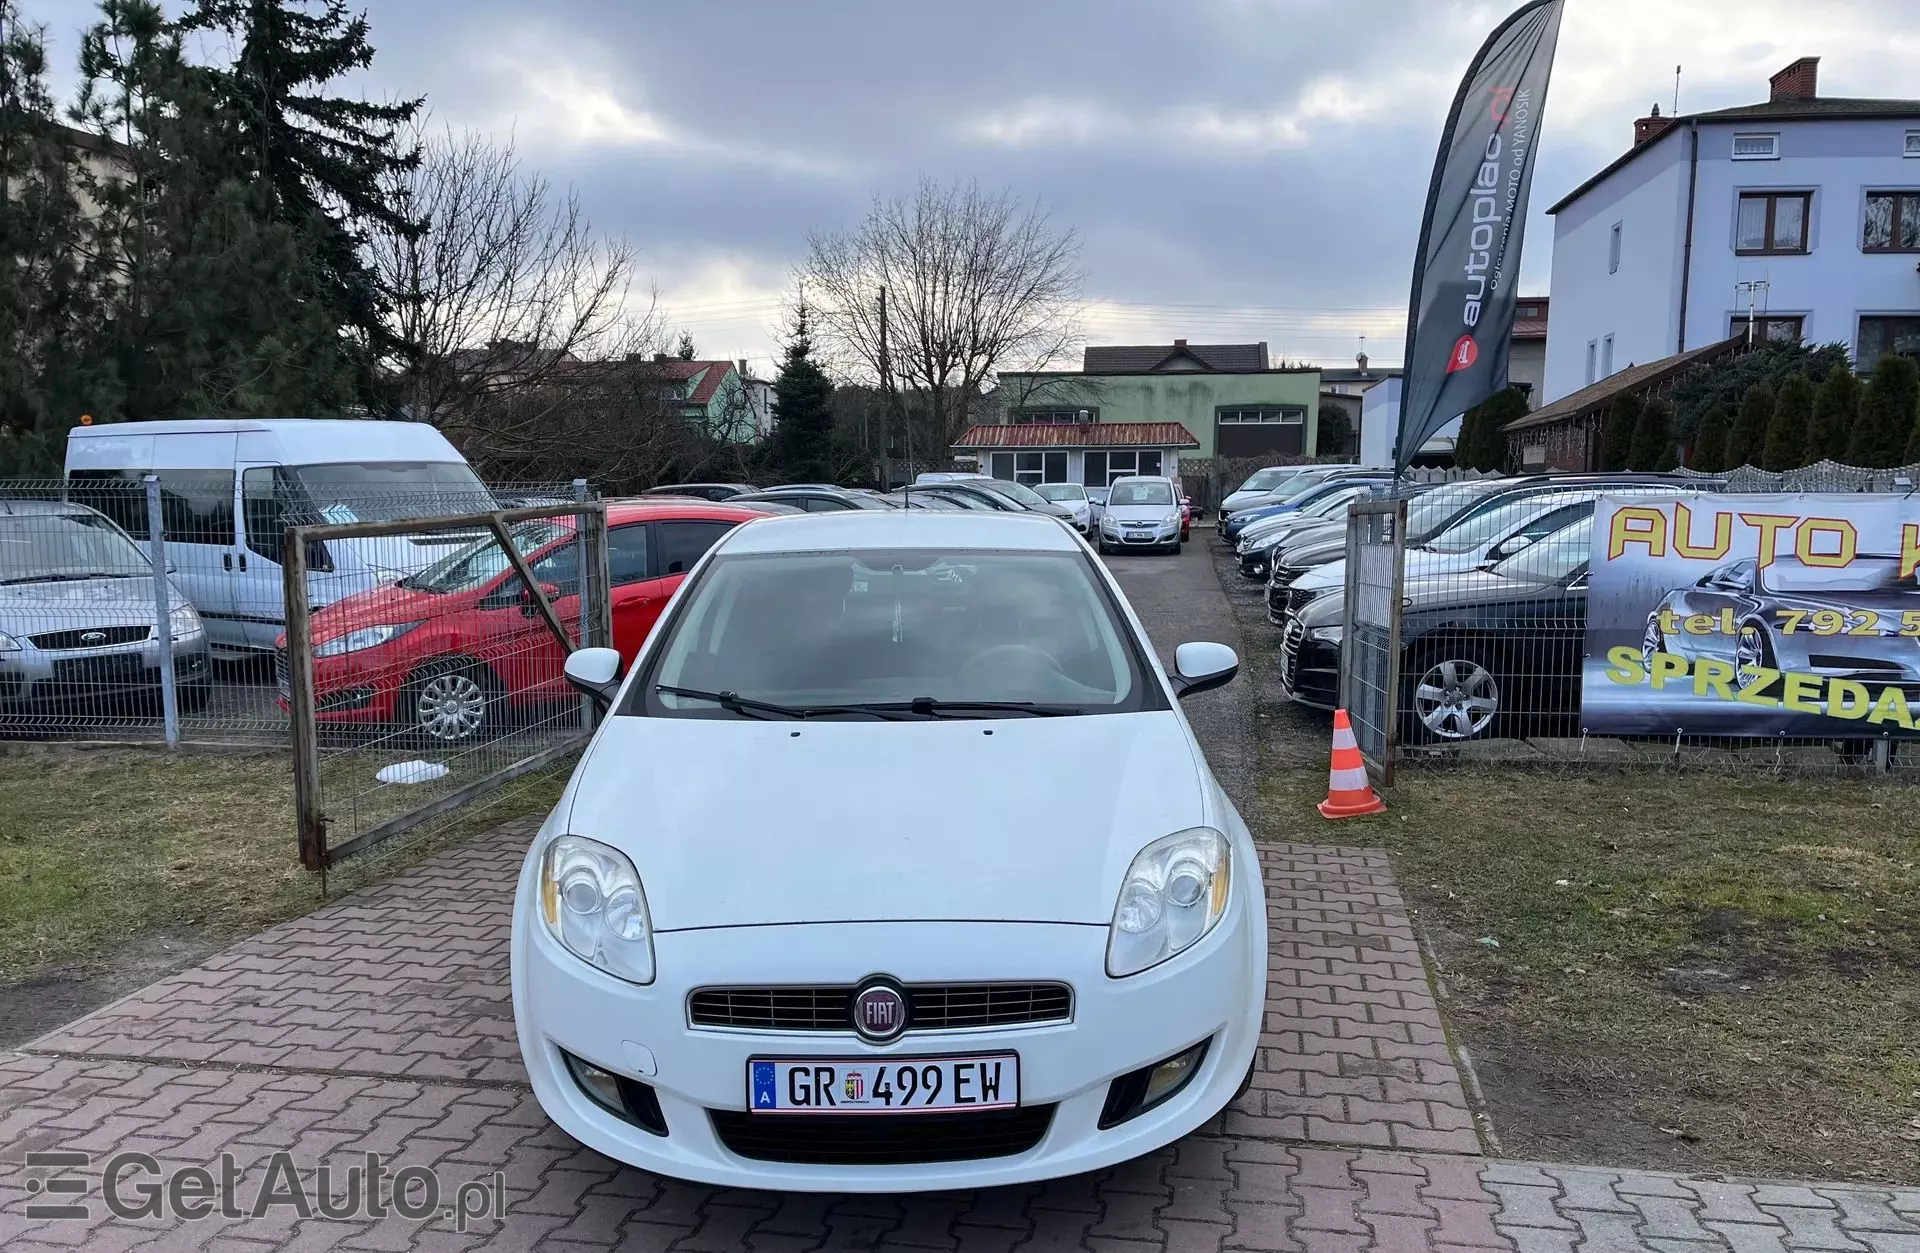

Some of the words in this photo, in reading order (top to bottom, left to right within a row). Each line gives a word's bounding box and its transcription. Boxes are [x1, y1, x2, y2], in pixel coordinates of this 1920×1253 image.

[1512, 88, 1531, 147] YANOSIK
[1512, 149, 1525, 166] od
[1463, 86, 1514, 327] autoplac.pl
[1505, 169, 1521, 212] MOTO
[1607, 501, 1858, 569] AUTO
[1656, 607, 1755, 635] tel.
[1776, 610, 1880, 637] 792
[1604, 645, 1920, 731] SPRZEDA
[866, 1001, 895, 1024] FIAT
[760, 1092, 771, 1104] A
[788, 1066, 837, 1106] GR
[872, 1065, 943, 1106] 499
[954, 1062, 1002, 1104] EW
